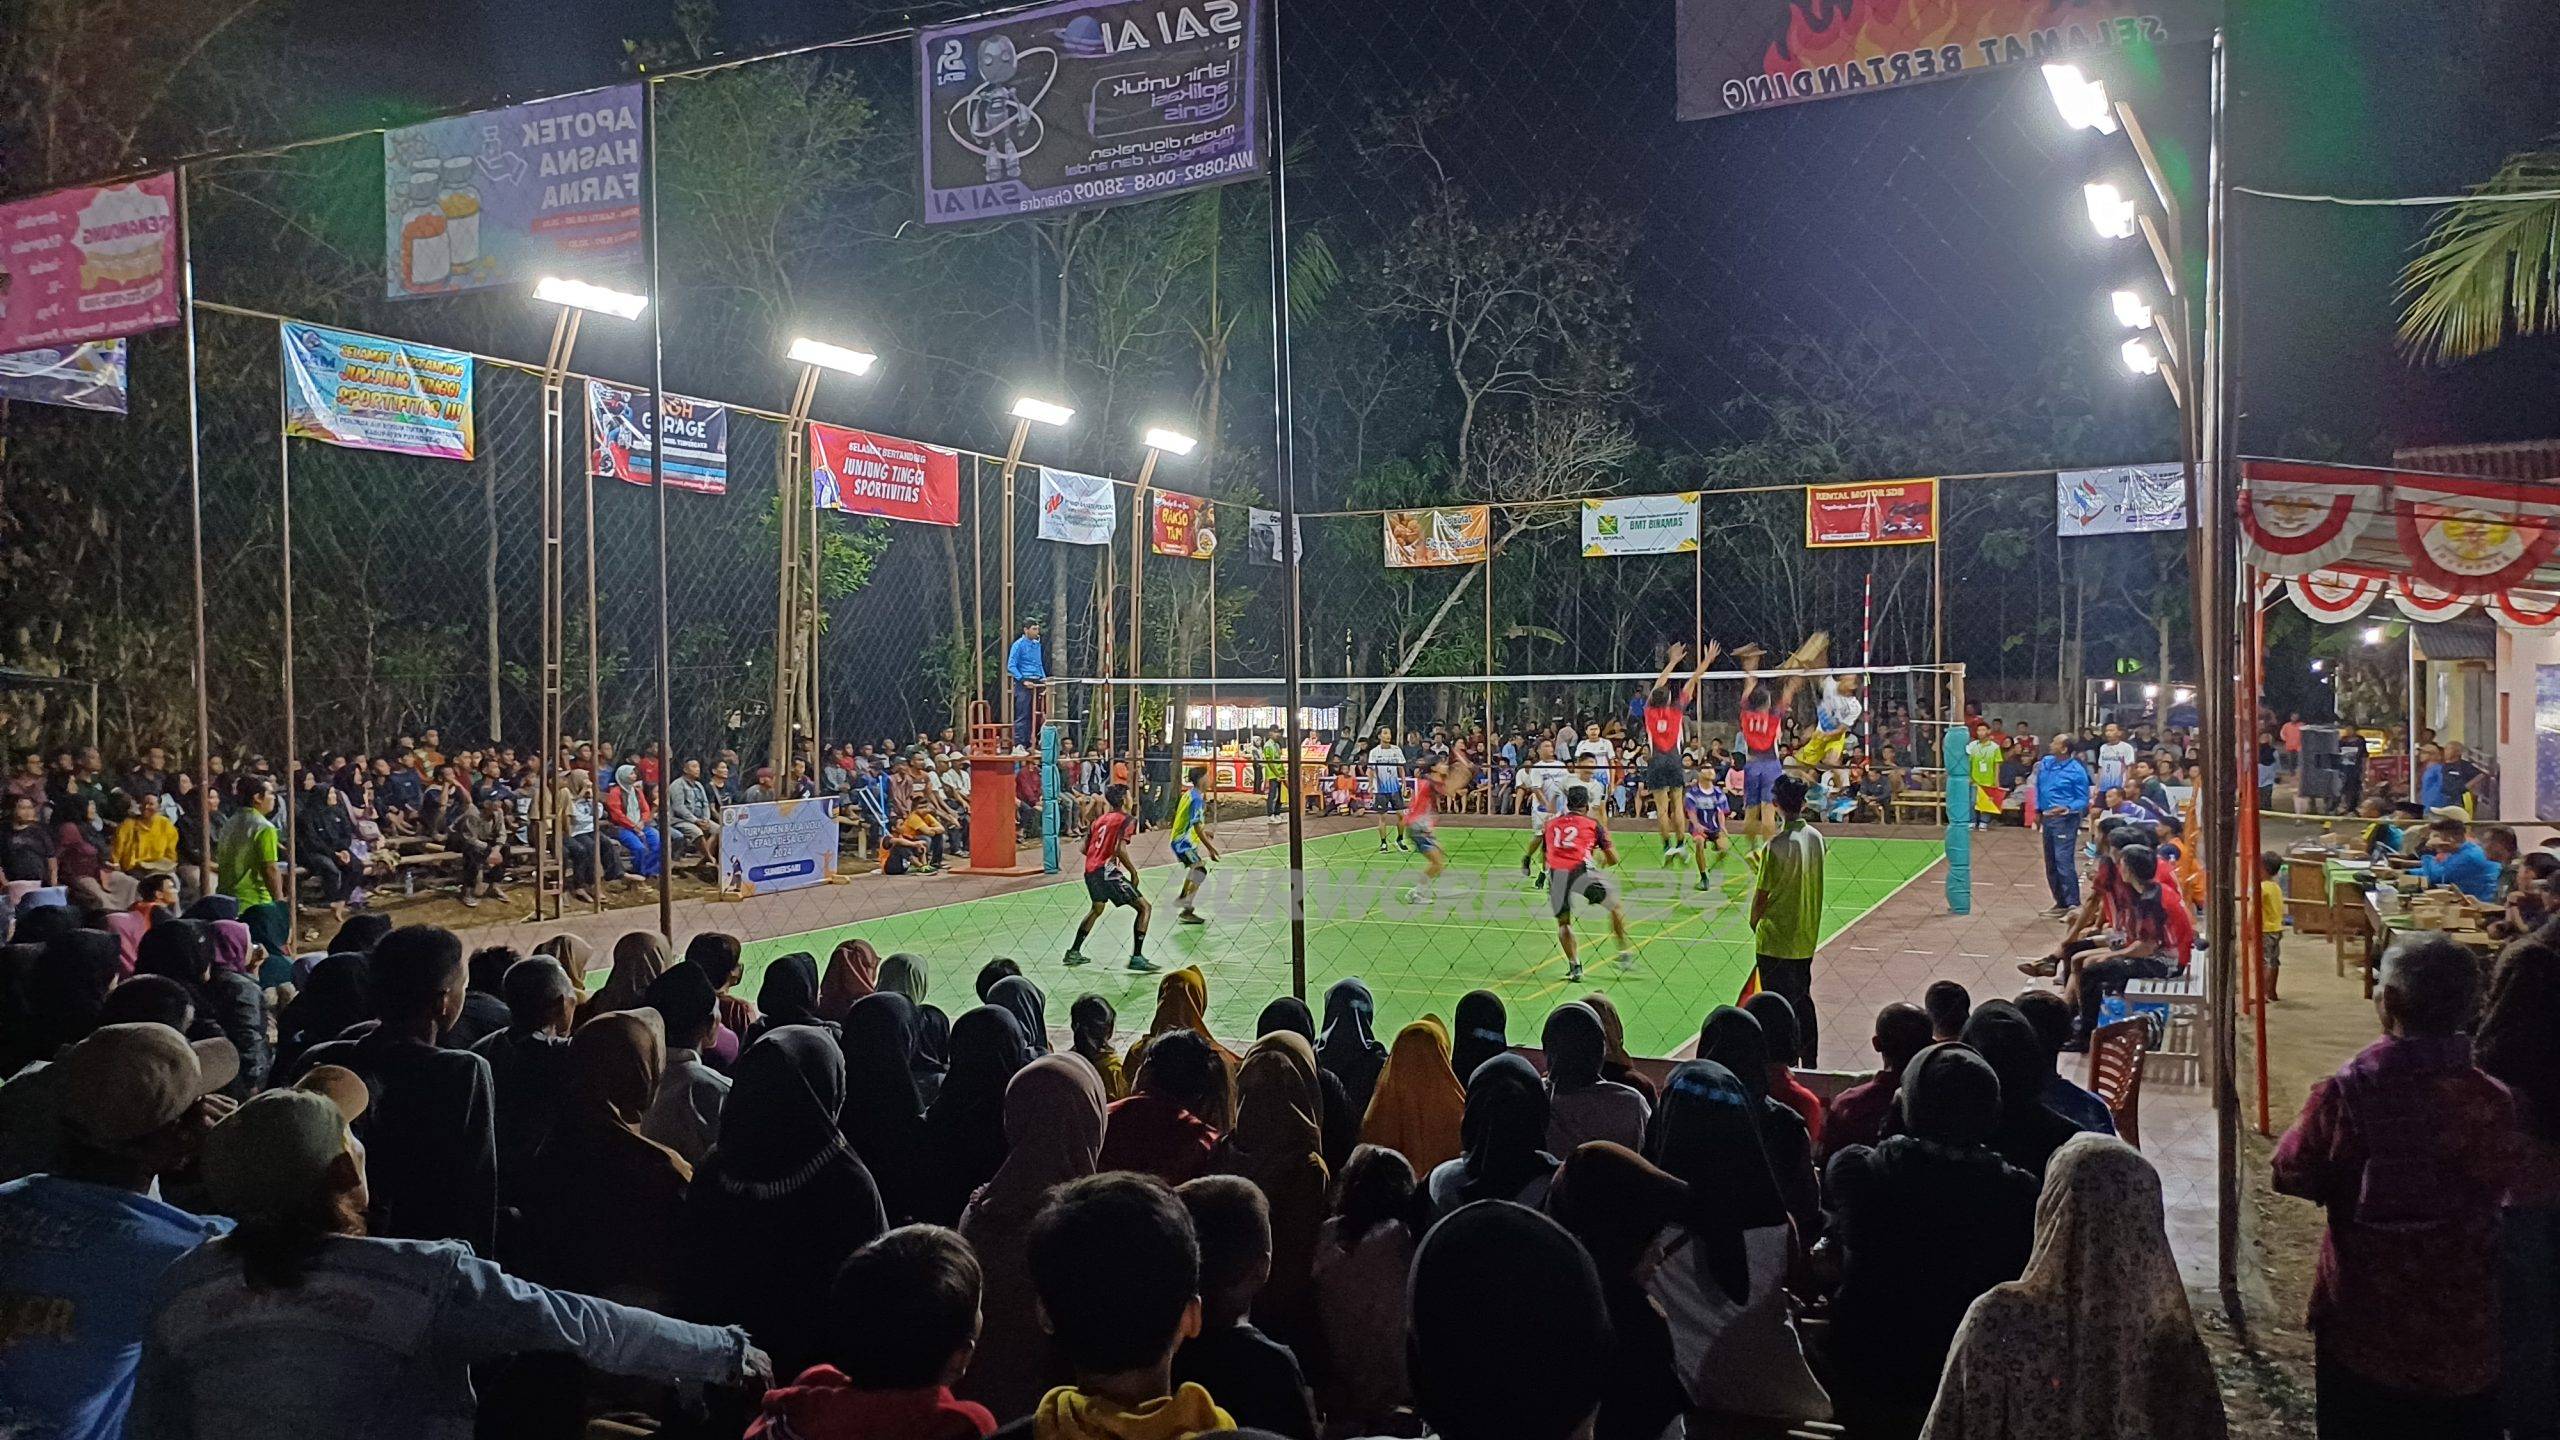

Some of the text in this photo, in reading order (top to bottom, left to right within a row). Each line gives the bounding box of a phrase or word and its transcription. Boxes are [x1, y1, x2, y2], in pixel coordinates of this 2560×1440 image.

[339, 344, 392, 364] SELAMAT
[395, 353, 465, 377] BRTANDING
[338, 363, 462, 398] JUNJUNG TINGGI
[641, 411, 706, 439] GRAGE
[842, 456, 926, 487] JUNJUNG TINGGI
[854, 478, 920, 504] SPORTIVITAS
[1629, 519, 1646, 530] BMT
[1094, 824, 1107, 849] 3
[1553, 826, 1579, 849] 12
